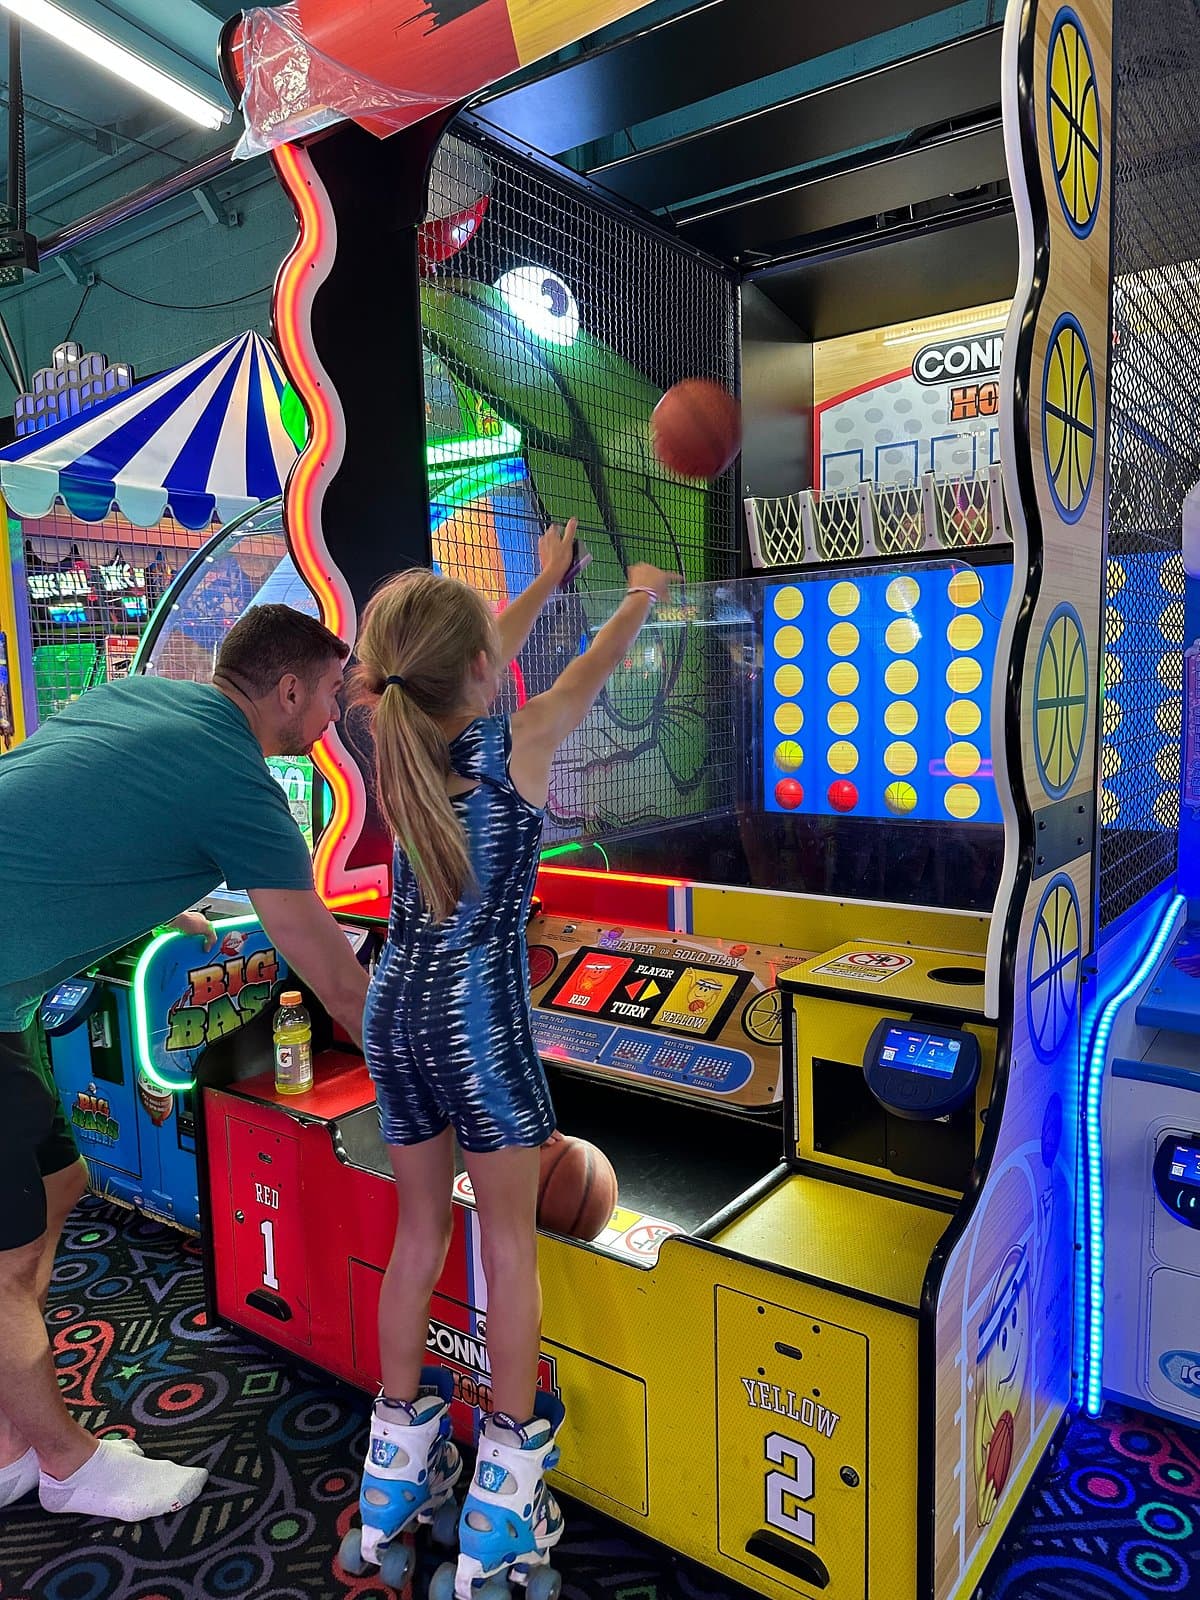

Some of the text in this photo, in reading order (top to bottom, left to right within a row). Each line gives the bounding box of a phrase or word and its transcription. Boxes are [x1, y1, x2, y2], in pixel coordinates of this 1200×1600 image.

[672, 949, 706, 962] SOLO
[705, 954, 744, 968] PLAY
[188, 947, 279, 1007] BIG
[634, 964, 675, 979] PLAYER
[568, 993, 591, 1007] RED
[610, 1001, 651, 1019] TURN
[660, 1011, 708, 1030] YELLOW
[254, 1182, 280, 1210] RED
[260, 1220, 280, 1291] 1
[740, 1377, 841, 1439] YELLOW
[765, 1431, 815, 1546] 2
